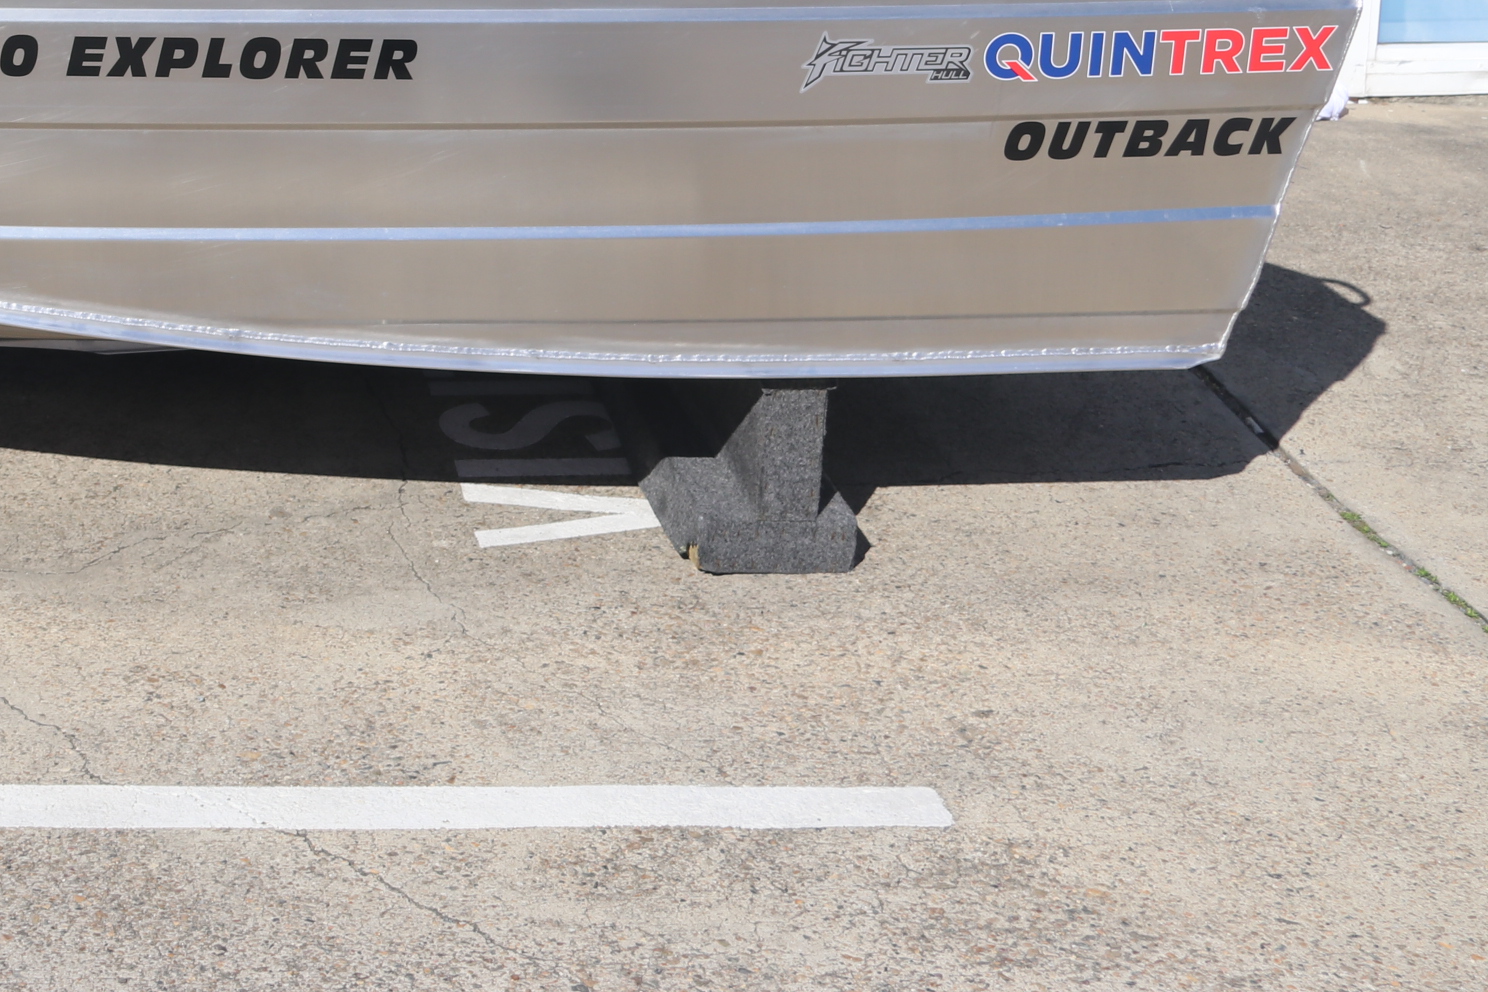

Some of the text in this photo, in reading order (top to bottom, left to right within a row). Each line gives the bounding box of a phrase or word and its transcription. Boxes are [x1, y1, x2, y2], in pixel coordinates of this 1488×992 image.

[66, 36, 418, 80] EXPLORER
[930, 70, 969, 81] HULL
[984, 26, 1338, 82] QUINTREX
[1004, 117, 1297, 161] OUTBACK
